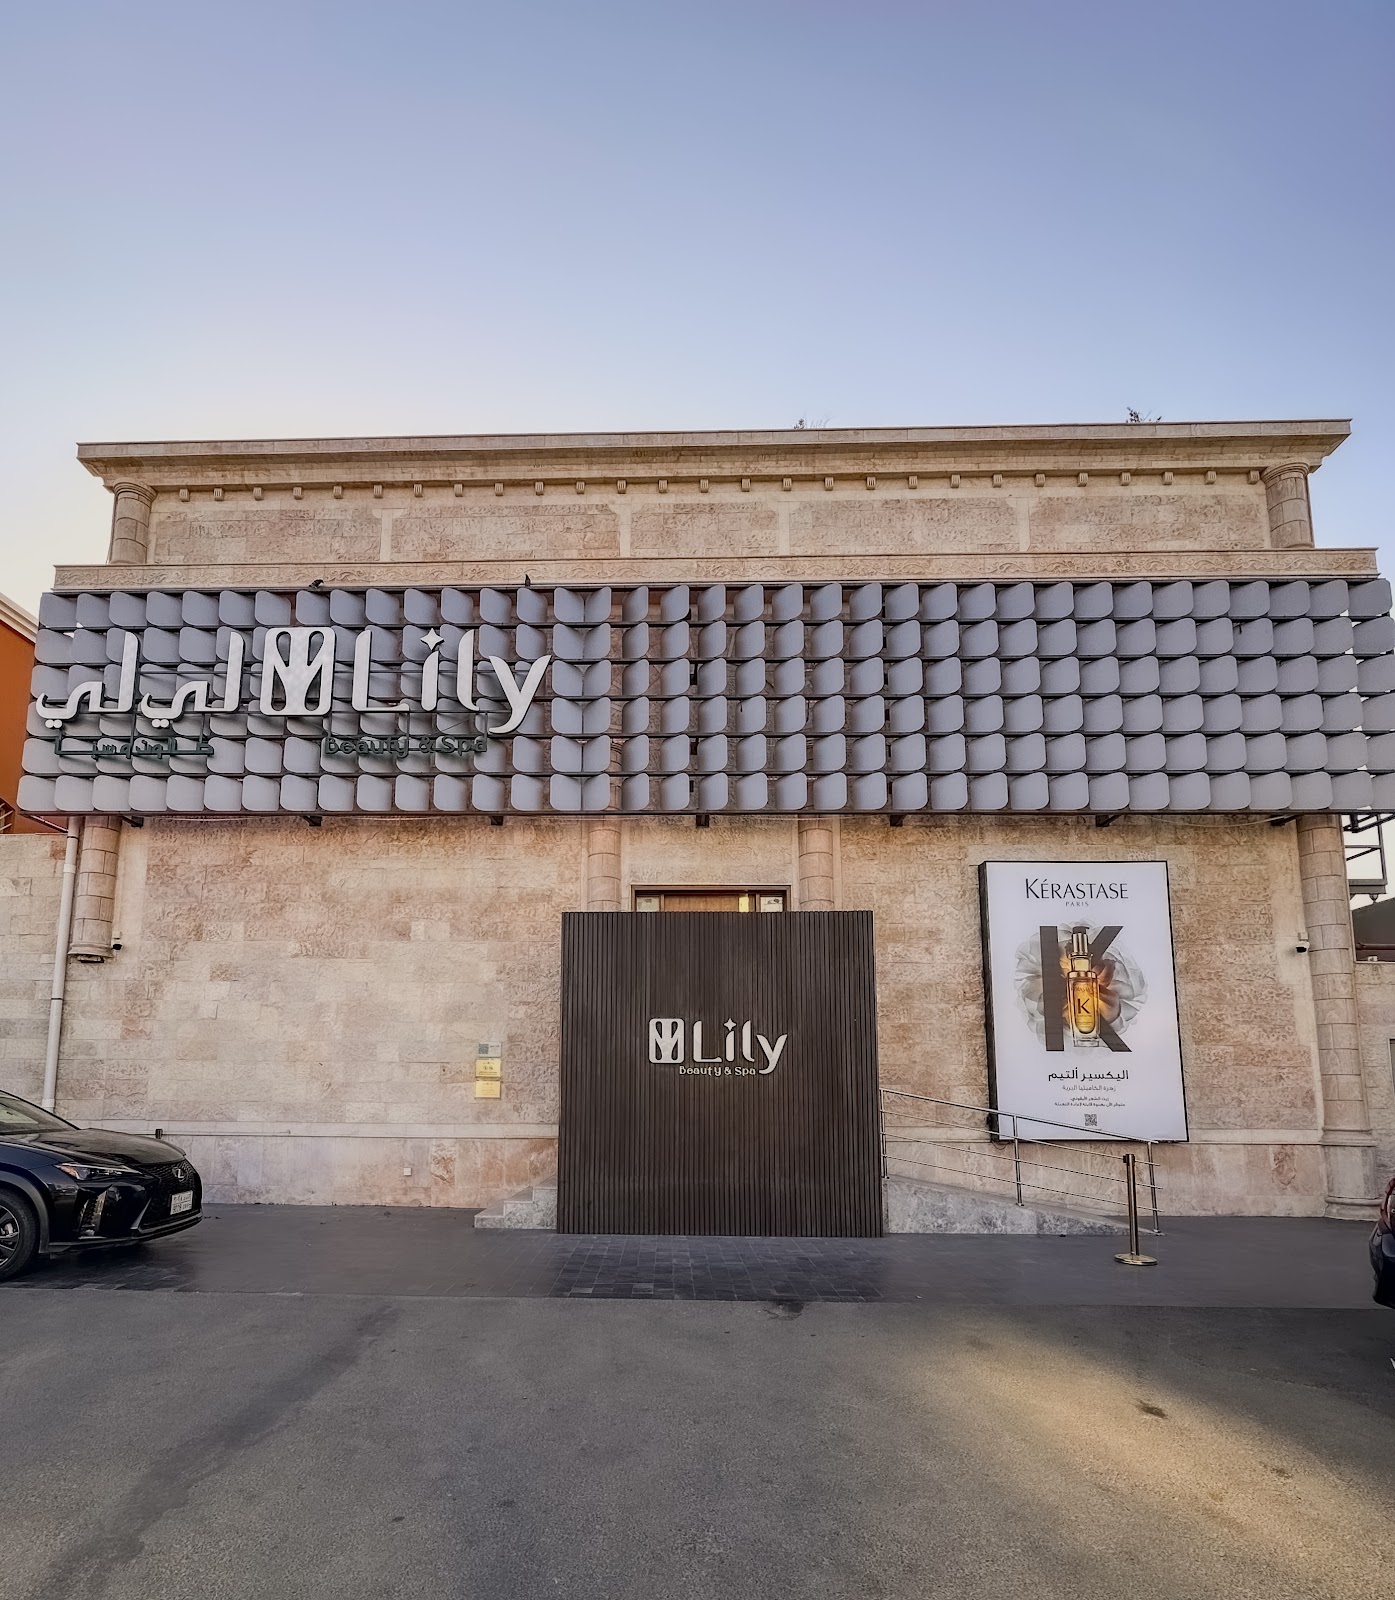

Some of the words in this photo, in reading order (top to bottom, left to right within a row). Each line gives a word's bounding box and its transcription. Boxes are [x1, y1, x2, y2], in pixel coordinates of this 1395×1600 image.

[352, 628, 552, 734] Lily
[325, 736, 410, 759] Beauty
[419, 736, 435, 754] &
[441, 736, 488, 757] Spa
[1025, 878, 1129, 900] KÉRASTASE
[1077, 998, 1091, 1014] K
[693, 1018, 788, 1075] Lily
[679, 1065, 722, 1077] Beauty
[724, 1066, 732, 1075] &
[735, 1066, 756, 1076] Spa
